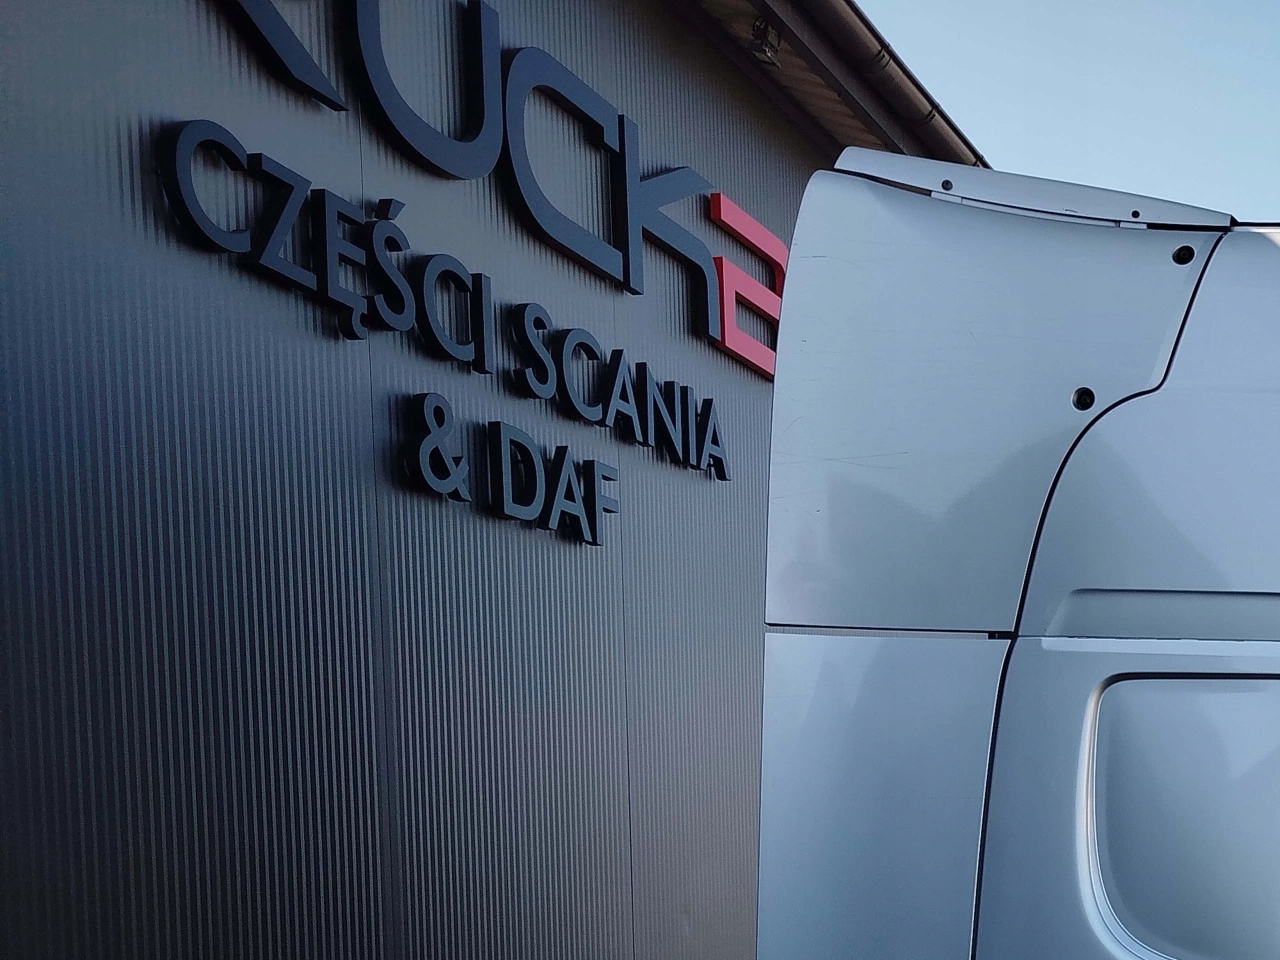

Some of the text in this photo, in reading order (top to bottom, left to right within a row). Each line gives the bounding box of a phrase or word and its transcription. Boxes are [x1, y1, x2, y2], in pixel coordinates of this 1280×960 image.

[162, 119, 732, 481] CZĘŚCI SCANIA
[412, 393, 619, 546] & DAF
